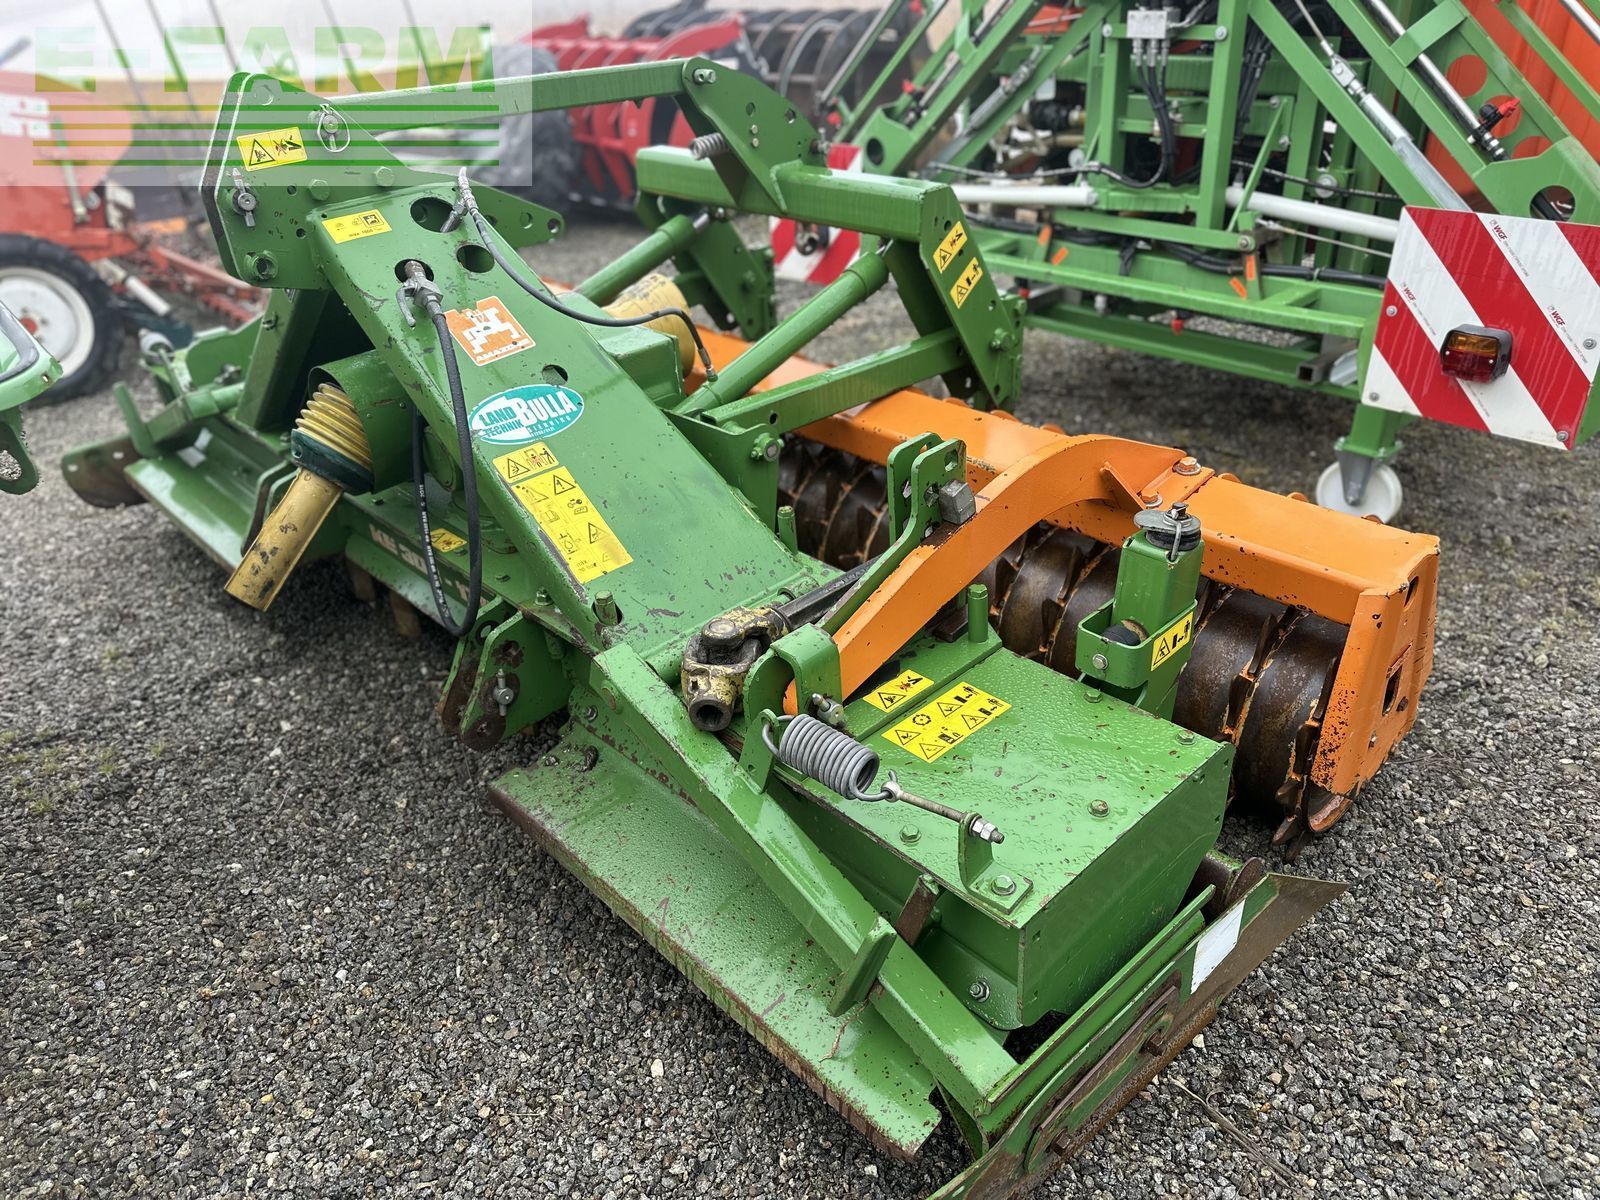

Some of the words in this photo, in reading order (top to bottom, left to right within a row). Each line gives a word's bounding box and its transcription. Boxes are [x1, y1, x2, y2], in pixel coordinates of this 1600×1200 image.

[1493, 224, 1508, 240] WGF
[1551, 310, 1566, 326] WGF
[479, 406, 518, 427] LAND
[510, 390, 578, 427] BULLA
[483, 419, 525, 437] TECHNIK
